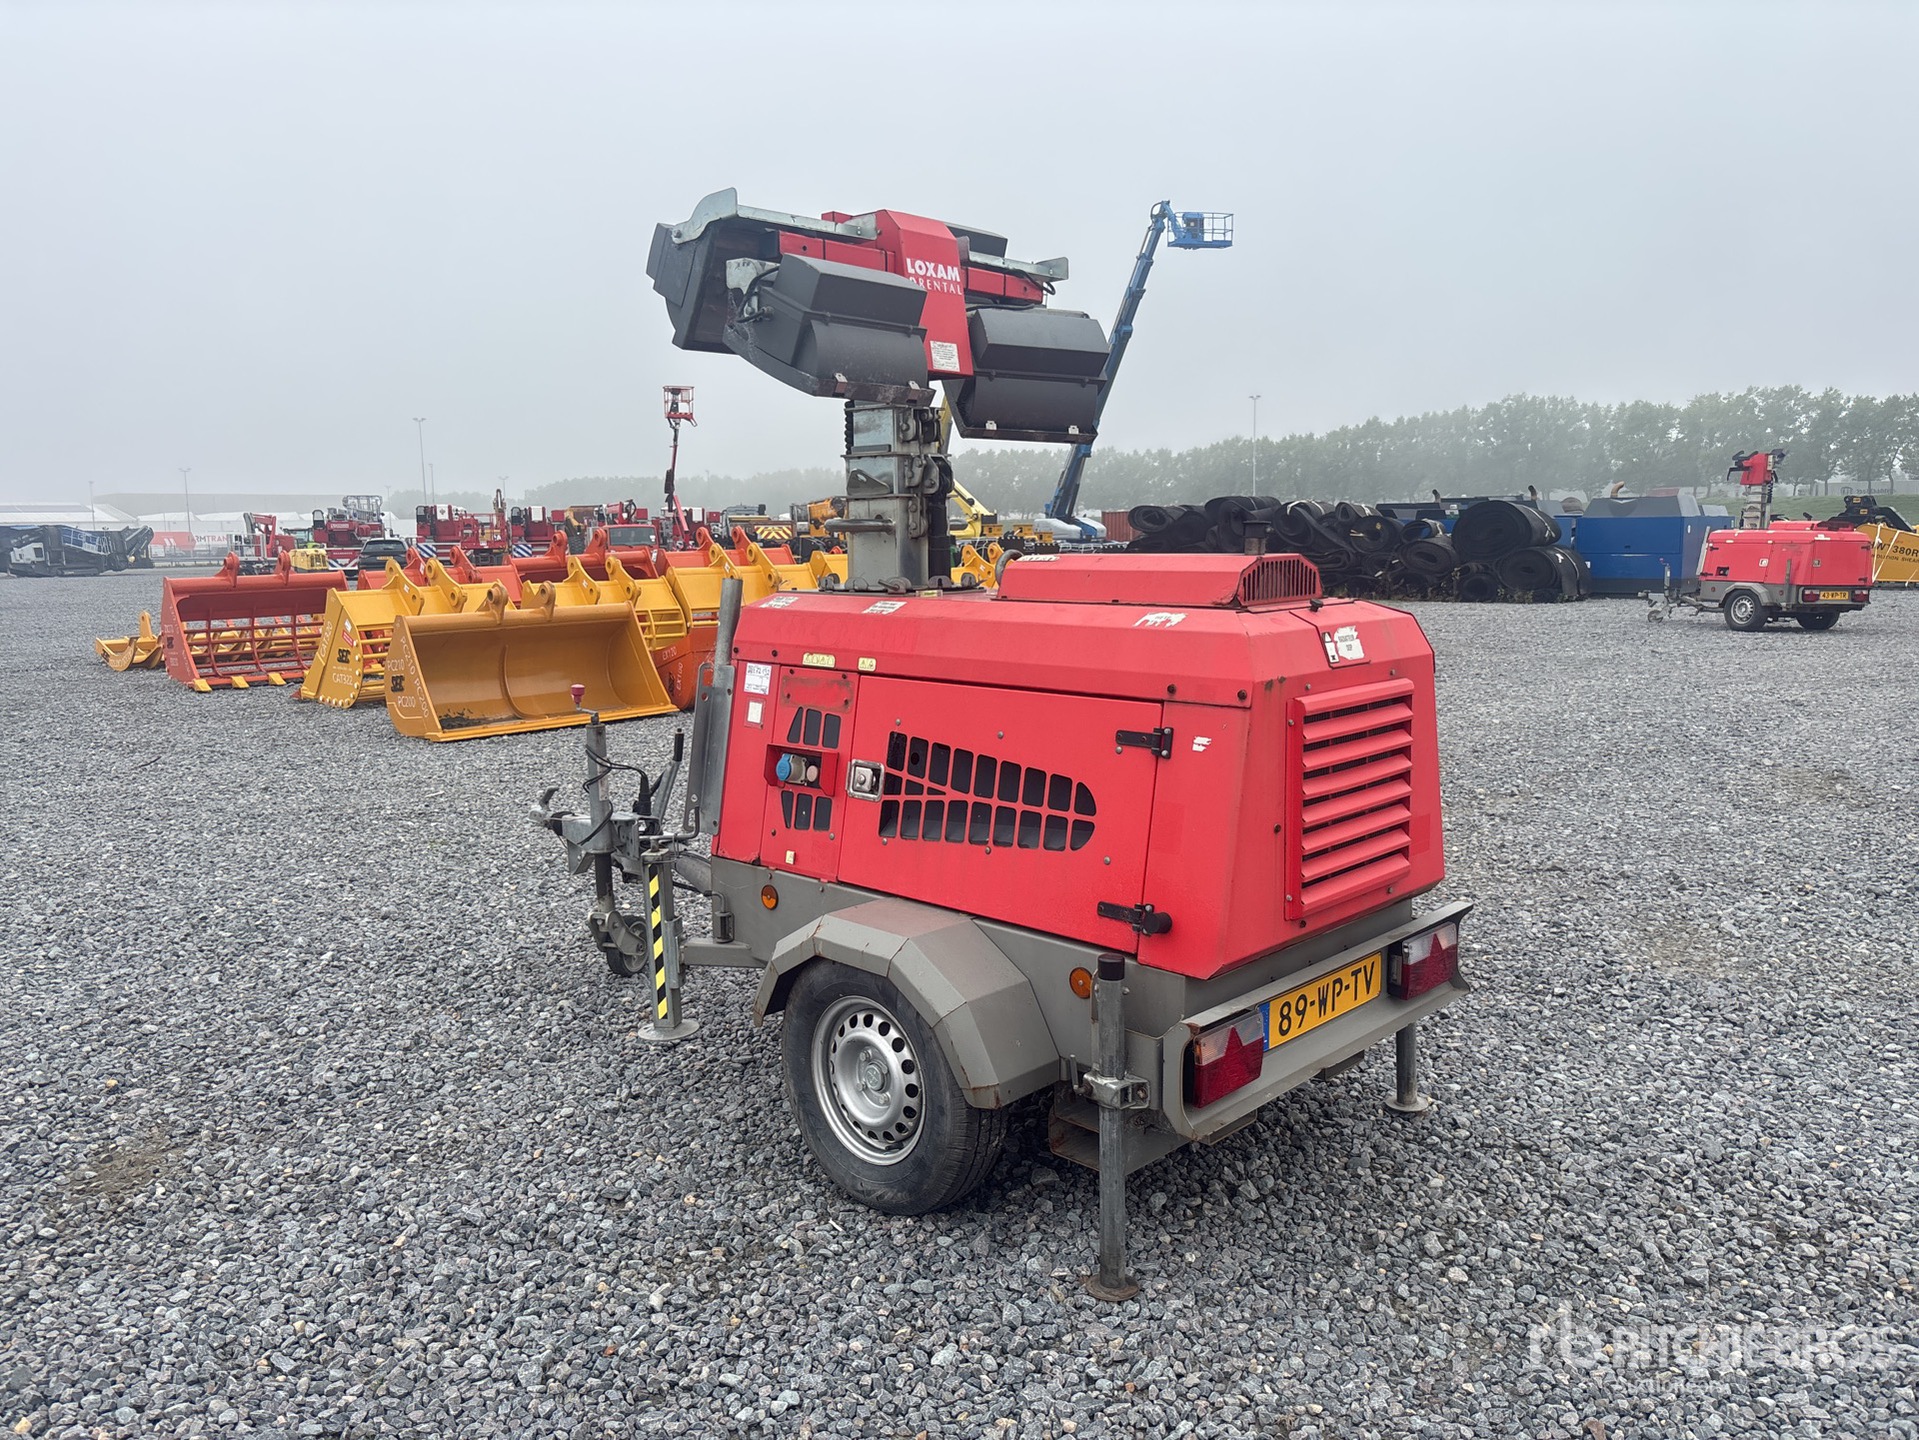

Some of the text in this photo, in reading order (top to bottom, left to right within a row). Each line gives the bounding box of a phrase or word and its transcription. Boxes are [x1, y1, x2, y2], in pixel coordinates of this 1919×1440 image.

[906, 257, 961, 282] LOXAM
[332, 672, 353, 686] CAT322
[397, 695, 416, 708] PC200
[1278, 961, 1375, 1037] 89-WP-TV
